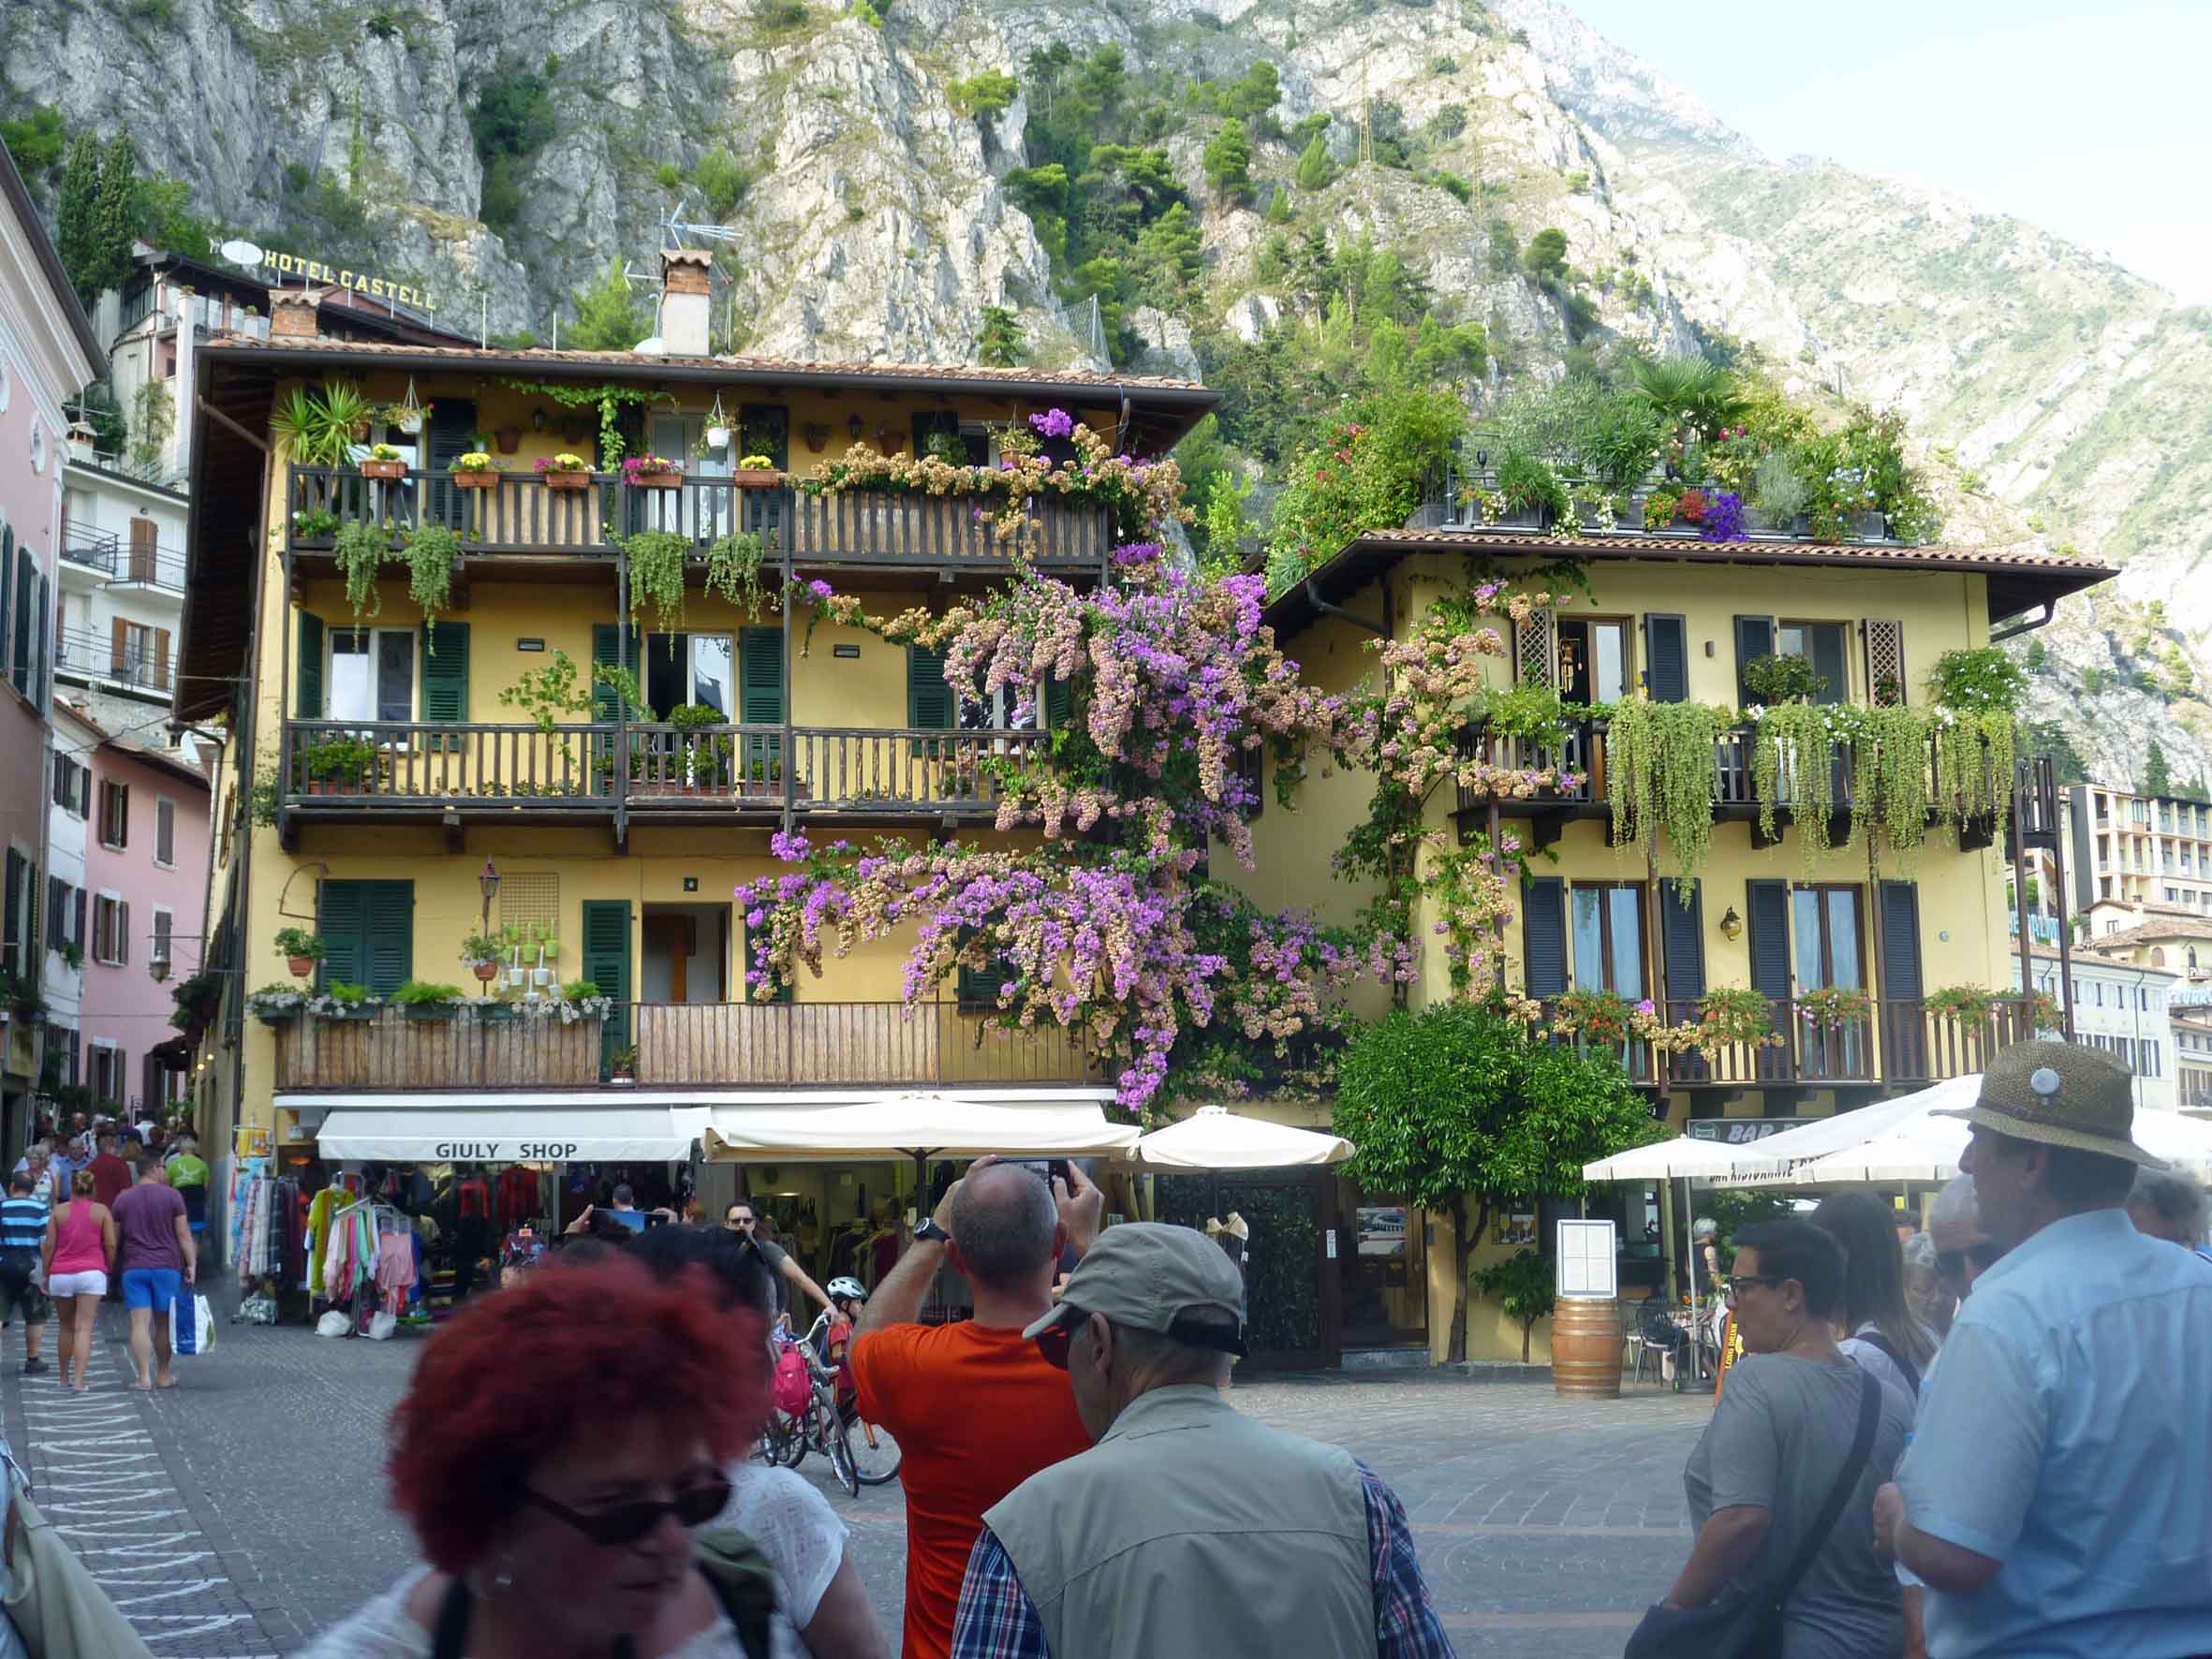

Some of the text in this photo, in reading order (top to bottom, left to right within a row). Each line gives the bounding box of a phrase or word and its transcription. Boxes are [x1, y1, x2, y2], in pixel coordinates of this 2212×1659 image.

[264, 250, 436, 311] HOTEL CASTELL
[435, 1143, 578, 1159] GIULY SHOP
[1724, 1348, 1734, 1369] LONG
